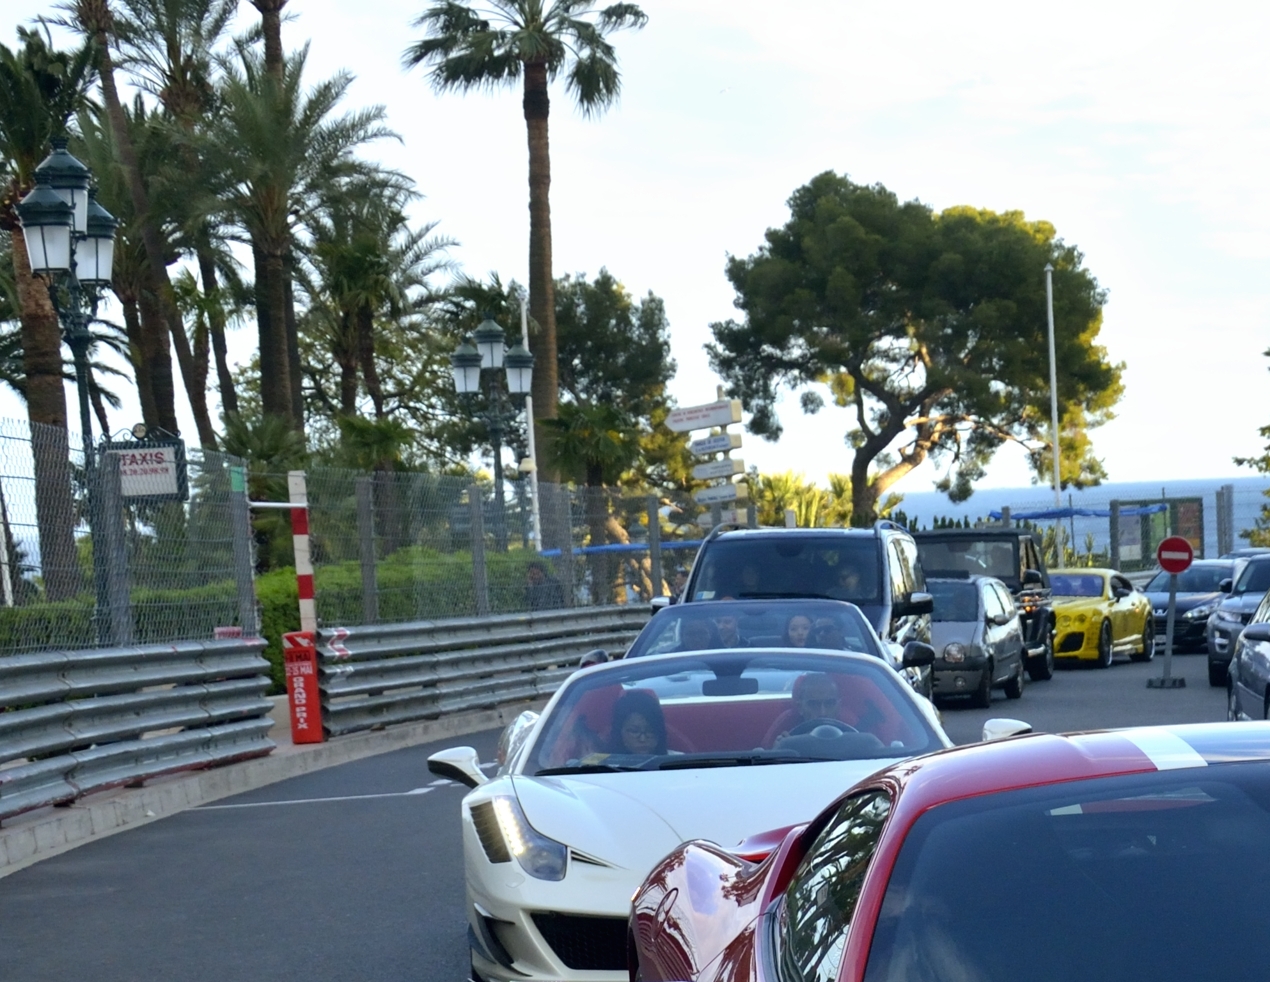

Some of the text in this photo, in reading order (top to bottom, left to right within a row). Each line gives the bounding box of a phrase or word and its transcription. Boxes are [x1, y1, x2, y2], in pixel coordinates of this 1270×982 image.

[121, 452, 164, 466] TAXIS
[293, 677, 306, 704] GRAND
[295, 707, 308, 729] PRIX
